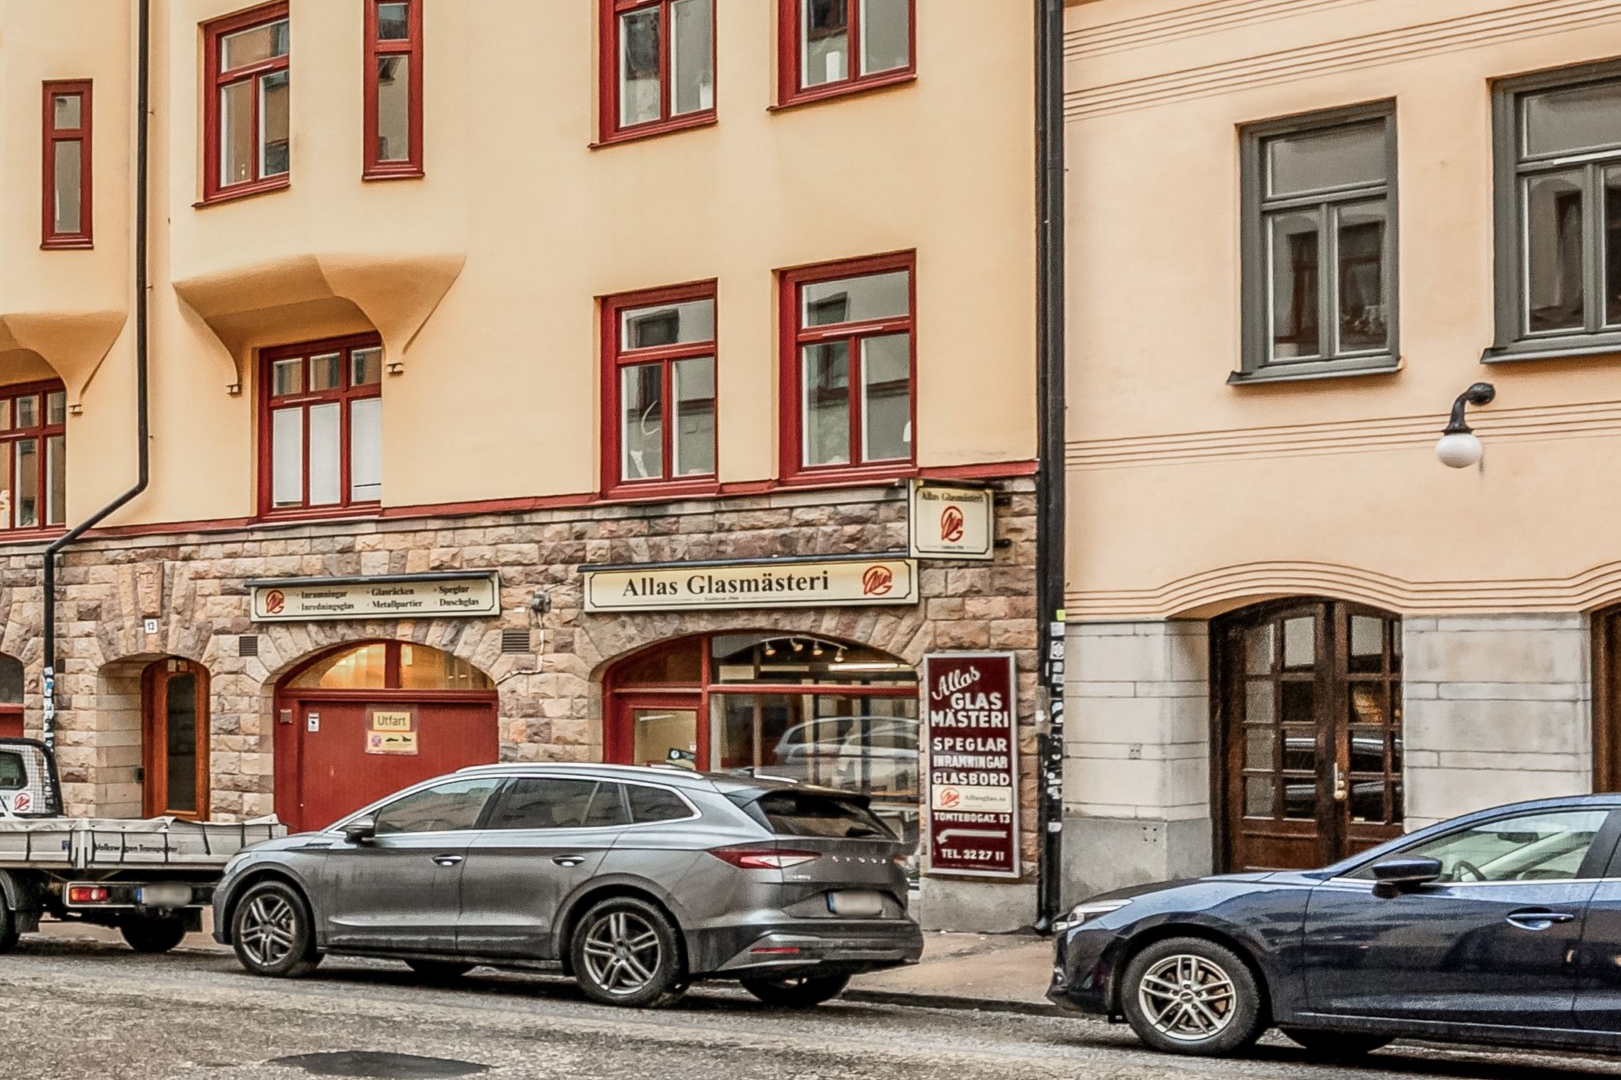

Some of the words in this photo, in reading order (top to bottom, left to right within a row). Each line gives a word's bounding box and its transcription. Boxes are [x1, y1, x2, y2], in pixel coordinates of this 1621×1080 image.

[438, 584, 470, 595] Speglar
[622, 577, 678, 597] Allas
[686, 570, 829, 595] Glasmästeri
[301, 602, 354, 611] Inredningsglas
[372, 599, 423, 609] Metallpartier
[439, 597, 479, 607] Duschglas
[931, 666, 981, 700] Allas
[950, 692, 1003, 710] GLAS
[377, 715, 406, 727] Utfart
[930, 708, 1009, 728] MÄSTERI
[933, 737, 1008, 752] SPEGLAR
[933, 755, 1008, 769] INRAMNINGAR
[932, 772, 1010, 786] GLASBORD
[999, 814, 1010, 824] 13
[94, 843, 138, 853] Volkswgen
[139, 843, 177, 853] Transpoter
[941, 848, 961, 859] TEL.
[963, 849, 976, 859] 32
[978, 850, 992, 860] 27
